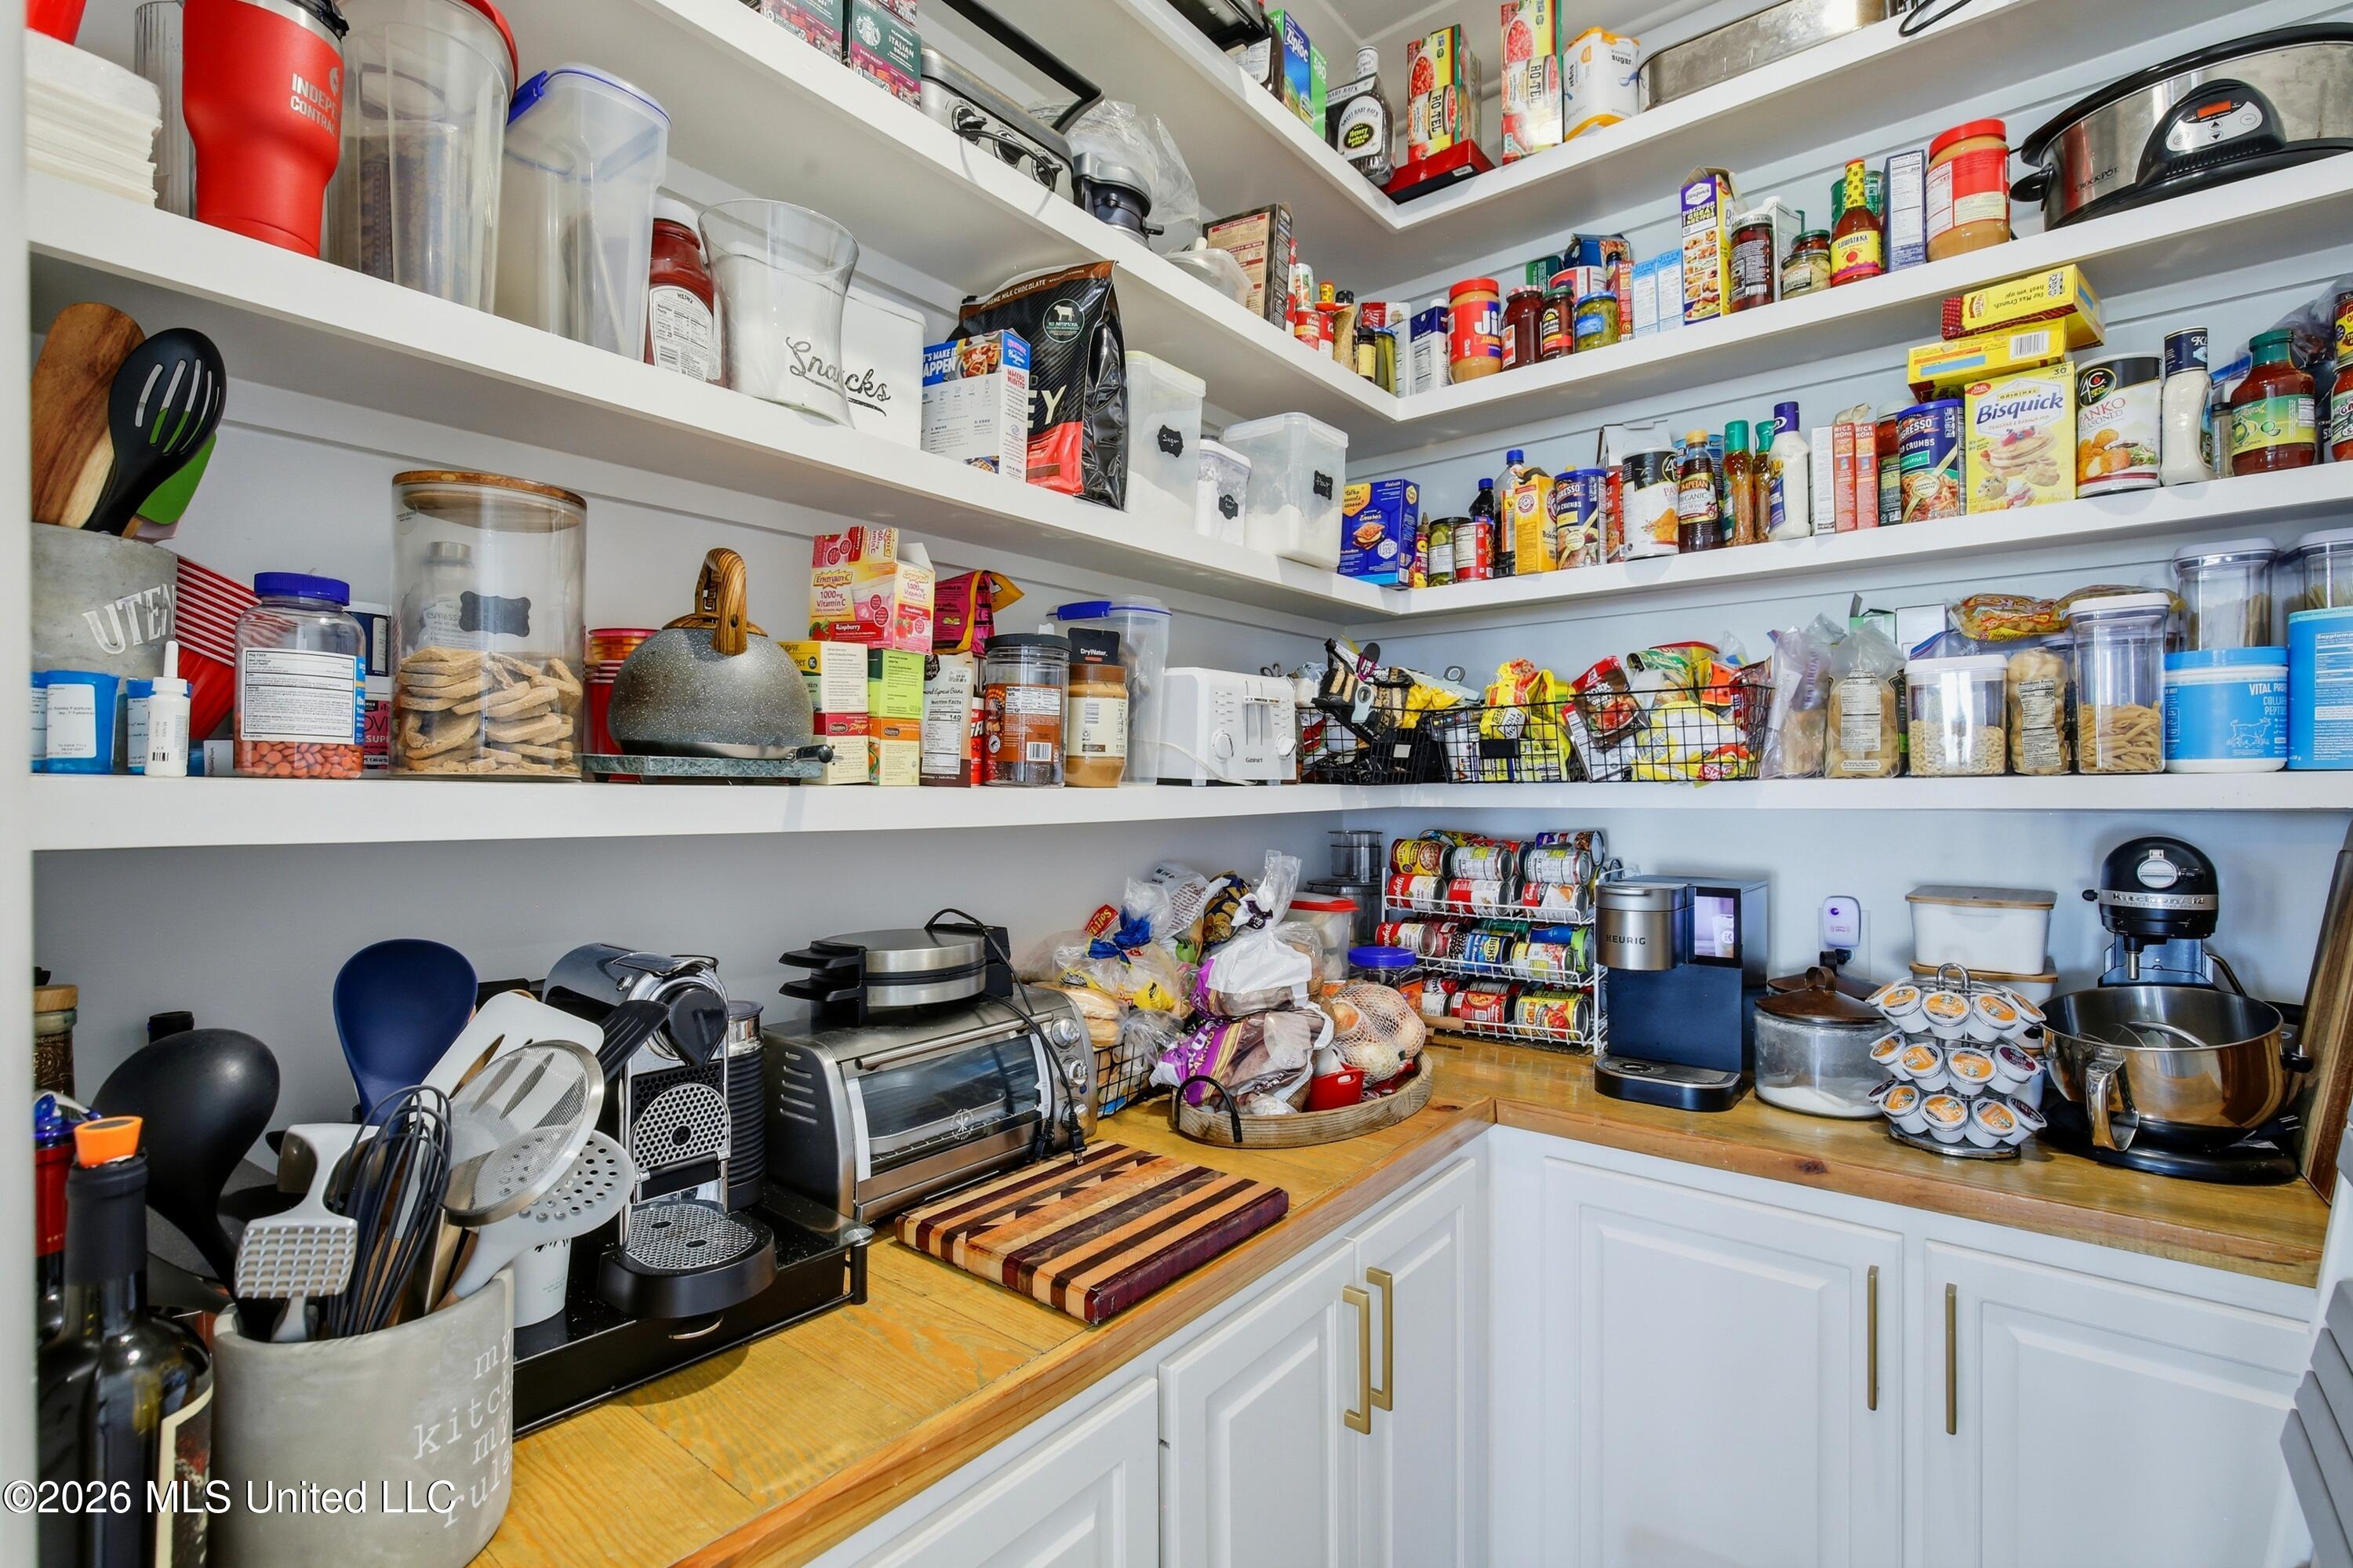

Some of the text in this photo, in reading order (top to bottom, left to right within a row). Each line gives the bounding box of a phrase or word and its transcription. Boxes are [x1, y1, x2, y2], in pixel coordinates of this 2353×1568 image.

[888, 35, 915, 59] ITALIAN
[1286, 27, 1309, 63] Ziploc
[1014, 278, 1046, 295] CHOCOLATE
[1474, 310, 1501, 337] Ji
[922, 358, 956, 378] APPEN
[1027, 385, 1067, 429] EY
[1977, 393, 2064, 424] Bisquick
[2078, 397, 2126, 427] PANKO
[1900, 419, 1932, 440] GRESSO
[1905, 438, 1936, 451] CRUMBS
[1679, 491, 1707, 501] RGANIC
[1584, 681, 1612, 698] PORK
[2249, 682, 2271, 696] VITAL
[365, 734, 389, 743] SUP
[1606, 933, 1646, 945] KEURIG
[472, 1327, 512, 1380] my
[413, 1370, 512, 1460] kitch
[472, 1406, 511, 1464] my
[444, 1453, 512, 1529] rule
